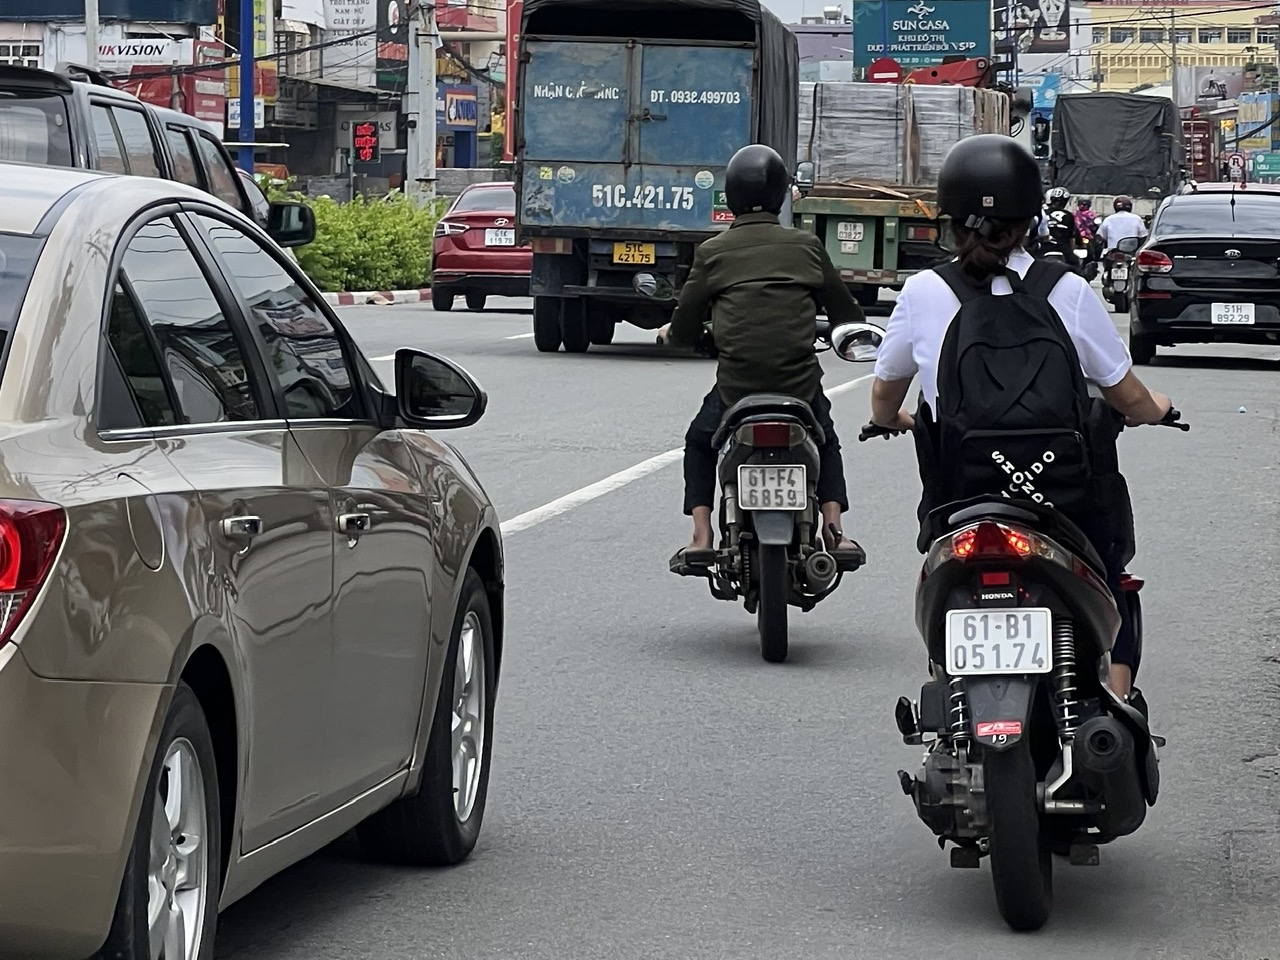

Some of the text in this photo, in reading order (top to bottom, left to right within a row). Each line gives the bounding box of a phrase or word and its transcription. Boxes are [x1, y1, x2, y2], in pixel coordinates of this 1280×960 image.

[892, 20, 950, 31] SUN CASA
[898, 33, 945, 43] KHU ĐÔ THỊ
[534, 82, 563, 100] NHẬN
[593, 184, 694, 210] 51C.421.75
[625, 243, 643, 252] 51C
[618, 253, 650, 262] 421.75
[1224, 304, 1243, 313] 51H
[748, 468, 796, 487] 61-F4
[749, 489, 797, 507] 6859
[982, 592, 1014, 600] HONDA
[963, 613, 1033, 641] 61-B1
[954, 642, 1044, 670] 051.74
